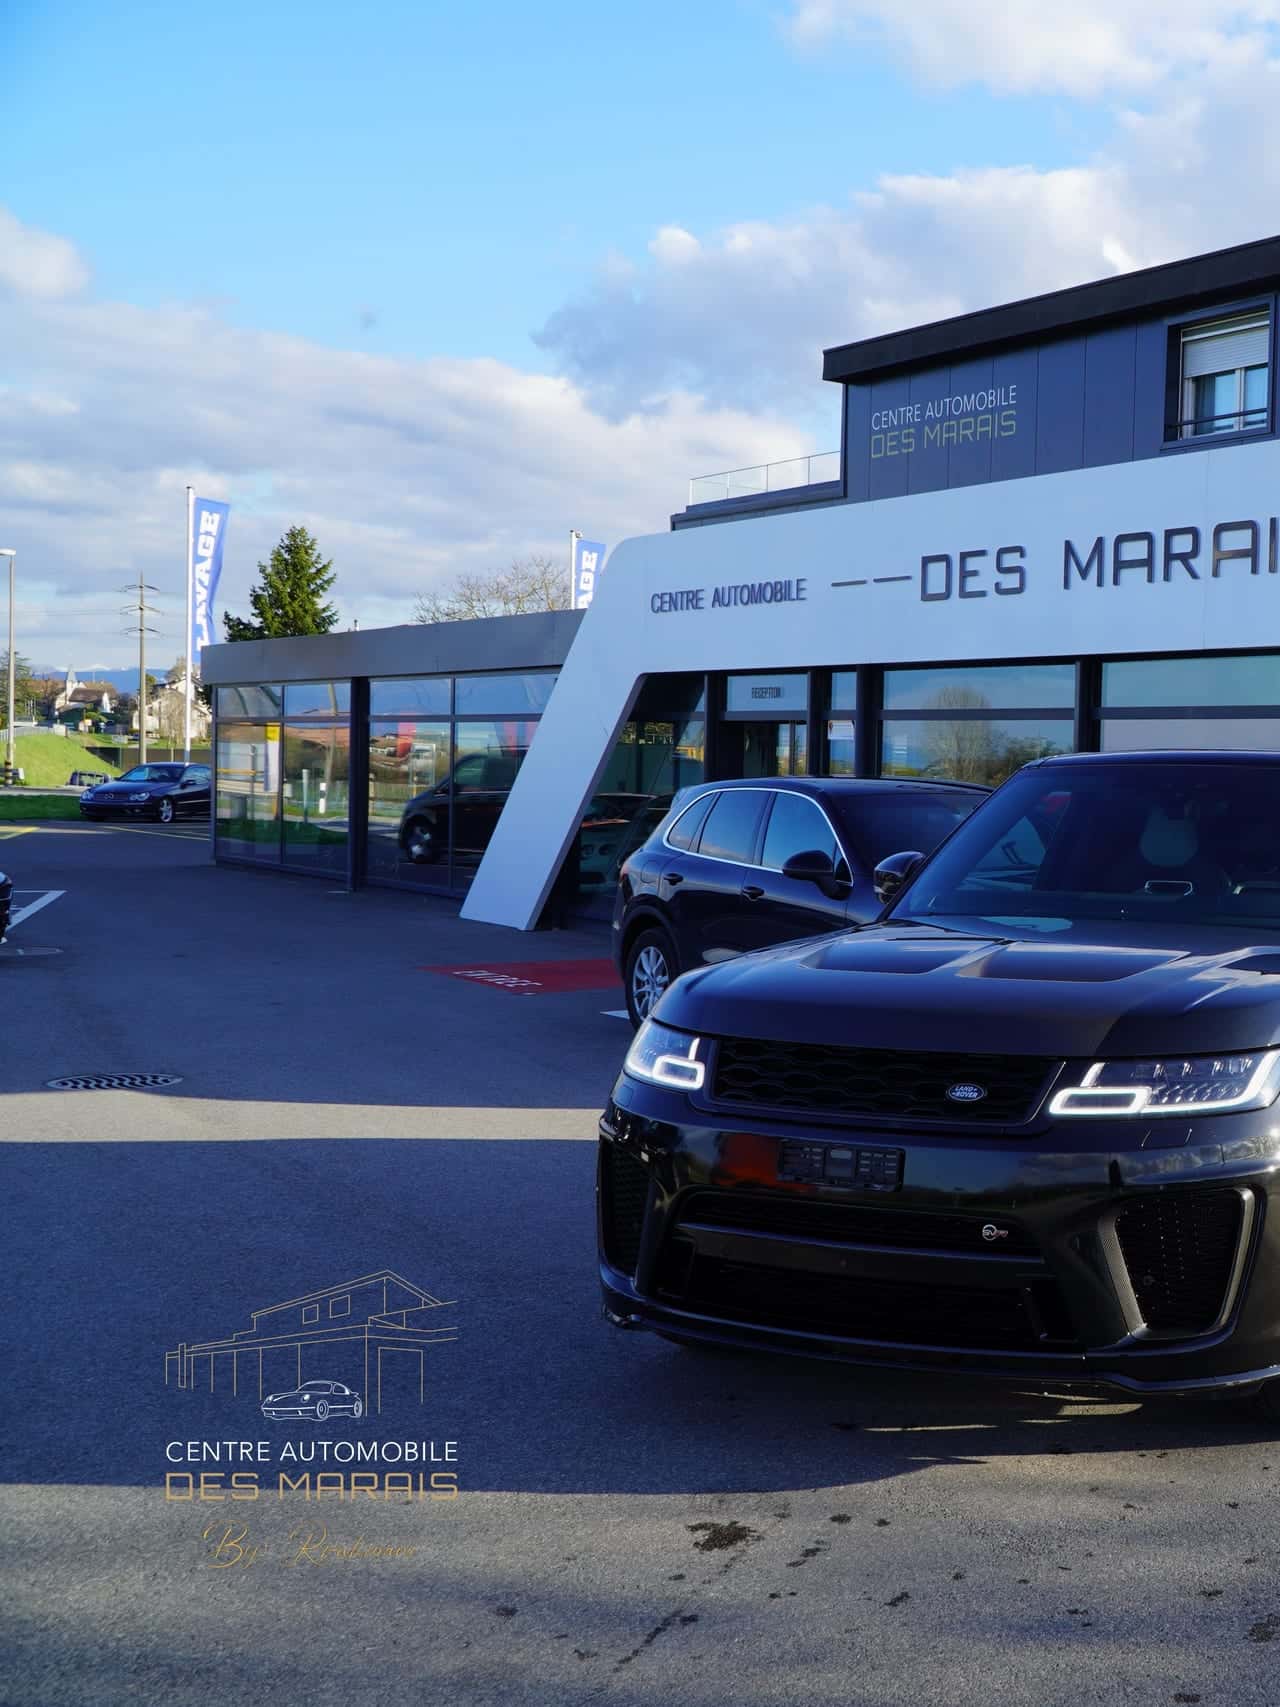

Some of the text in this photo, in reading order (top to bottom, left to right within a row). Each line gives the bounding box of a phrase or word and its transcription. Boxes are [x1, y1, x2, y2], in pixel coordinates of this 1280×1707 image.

[871, 410, 1017, 459] DES MARAIS
[872, 385, 1017, 431] CENTRE AUTOMOBILE
[195, 510, 221, 650] LAVAGE
[650, 589, 705, 614] CENTRE
[711, 578, 808, 608] AUTOMOBILE
[920, 545, 1025, 601] DES
